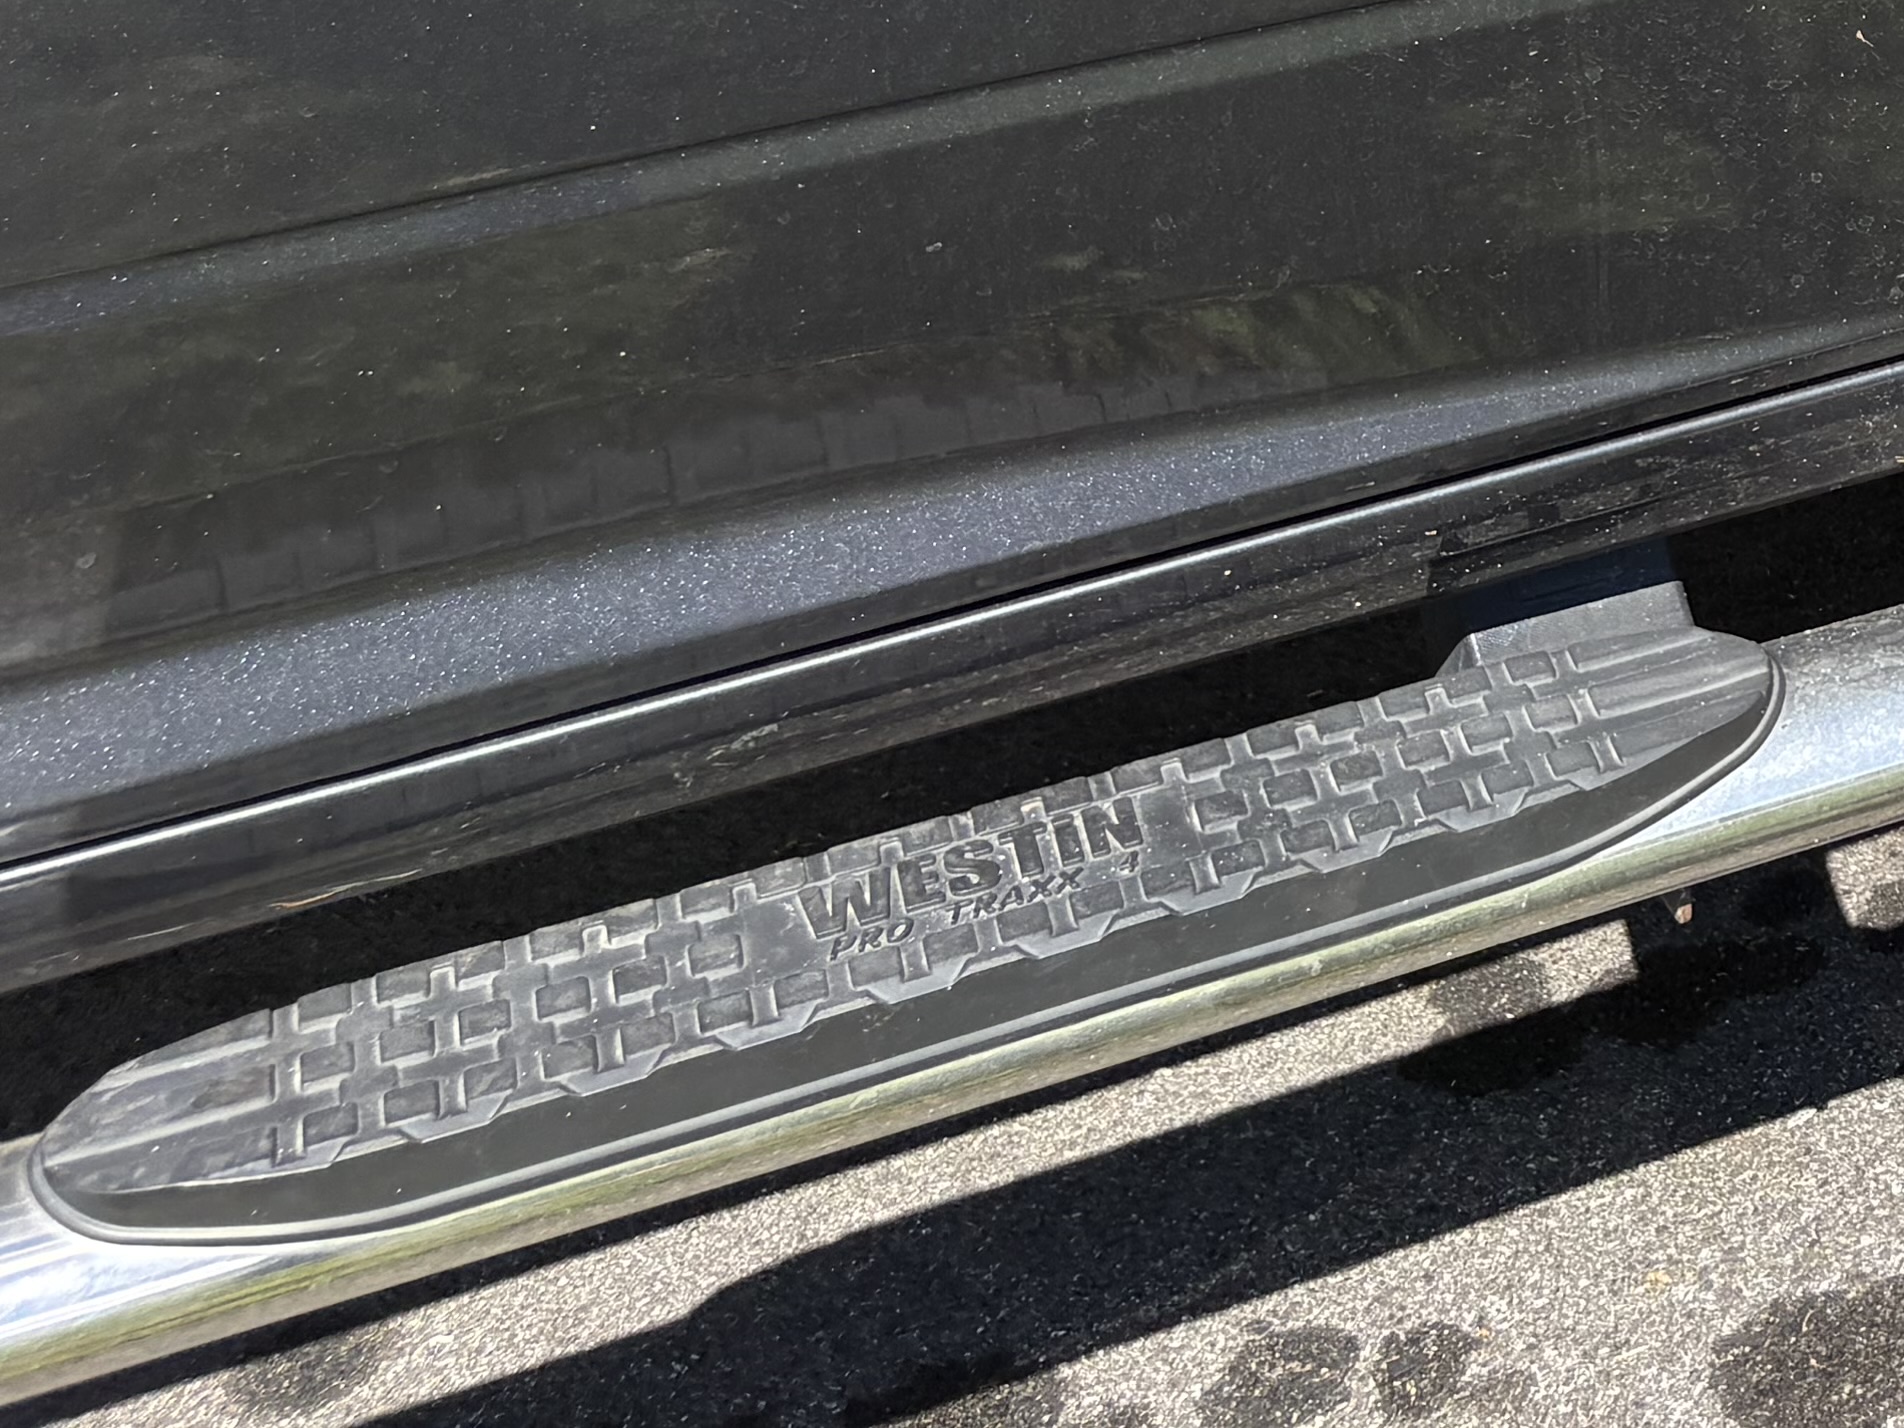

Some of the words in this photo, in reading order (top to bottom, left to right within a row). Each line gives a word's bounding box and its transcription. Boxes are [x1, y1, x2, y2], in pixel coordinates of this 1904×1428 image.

[800, 796, 1143, 939] WESTIN
[830, 917, 914, 962] PRO
[949, 867, 1082, 925] TRAXX
[1119, 851, 1140, 875] 4
